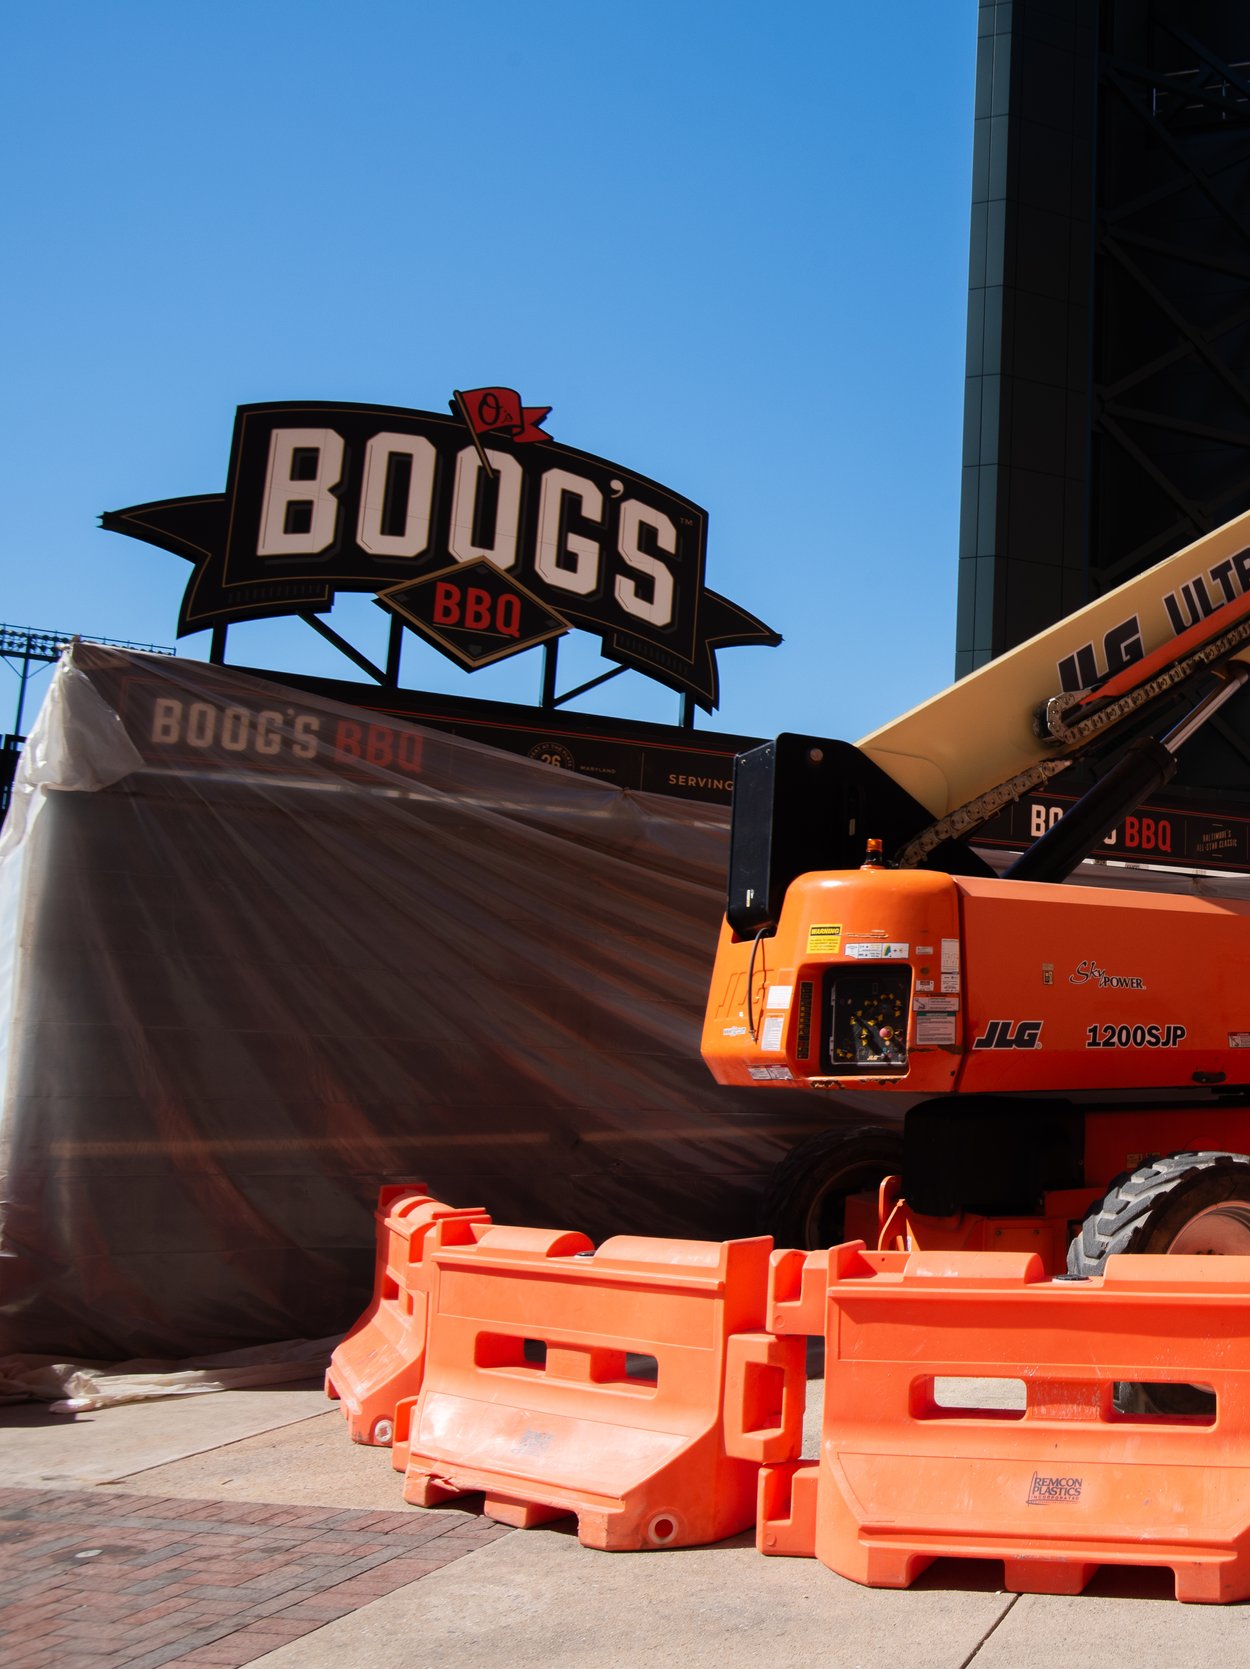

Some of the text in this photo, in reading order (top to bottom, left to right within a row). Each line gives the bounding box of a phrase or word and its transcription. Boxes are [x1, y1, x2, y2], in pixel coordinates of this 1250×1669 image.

[256, 427, 678, 628] BOOG'S
[432, 581, 521, 638] BBQ
[151, 697, 425, 774] BOOG'S BBQ
[668, 774, 735, 791] SERVING
[1125, 816, 1172, 853] BBQ
[811, 927, 840, 935] WARNING
[973, 1020, 1042, 1050] JLG
[1085, 1023, 1187, 1049] 1200SJP
[1032, 1487, 1082, 1496] PLASTICS
[1034, 1477, 1083, 1487] REMCON
